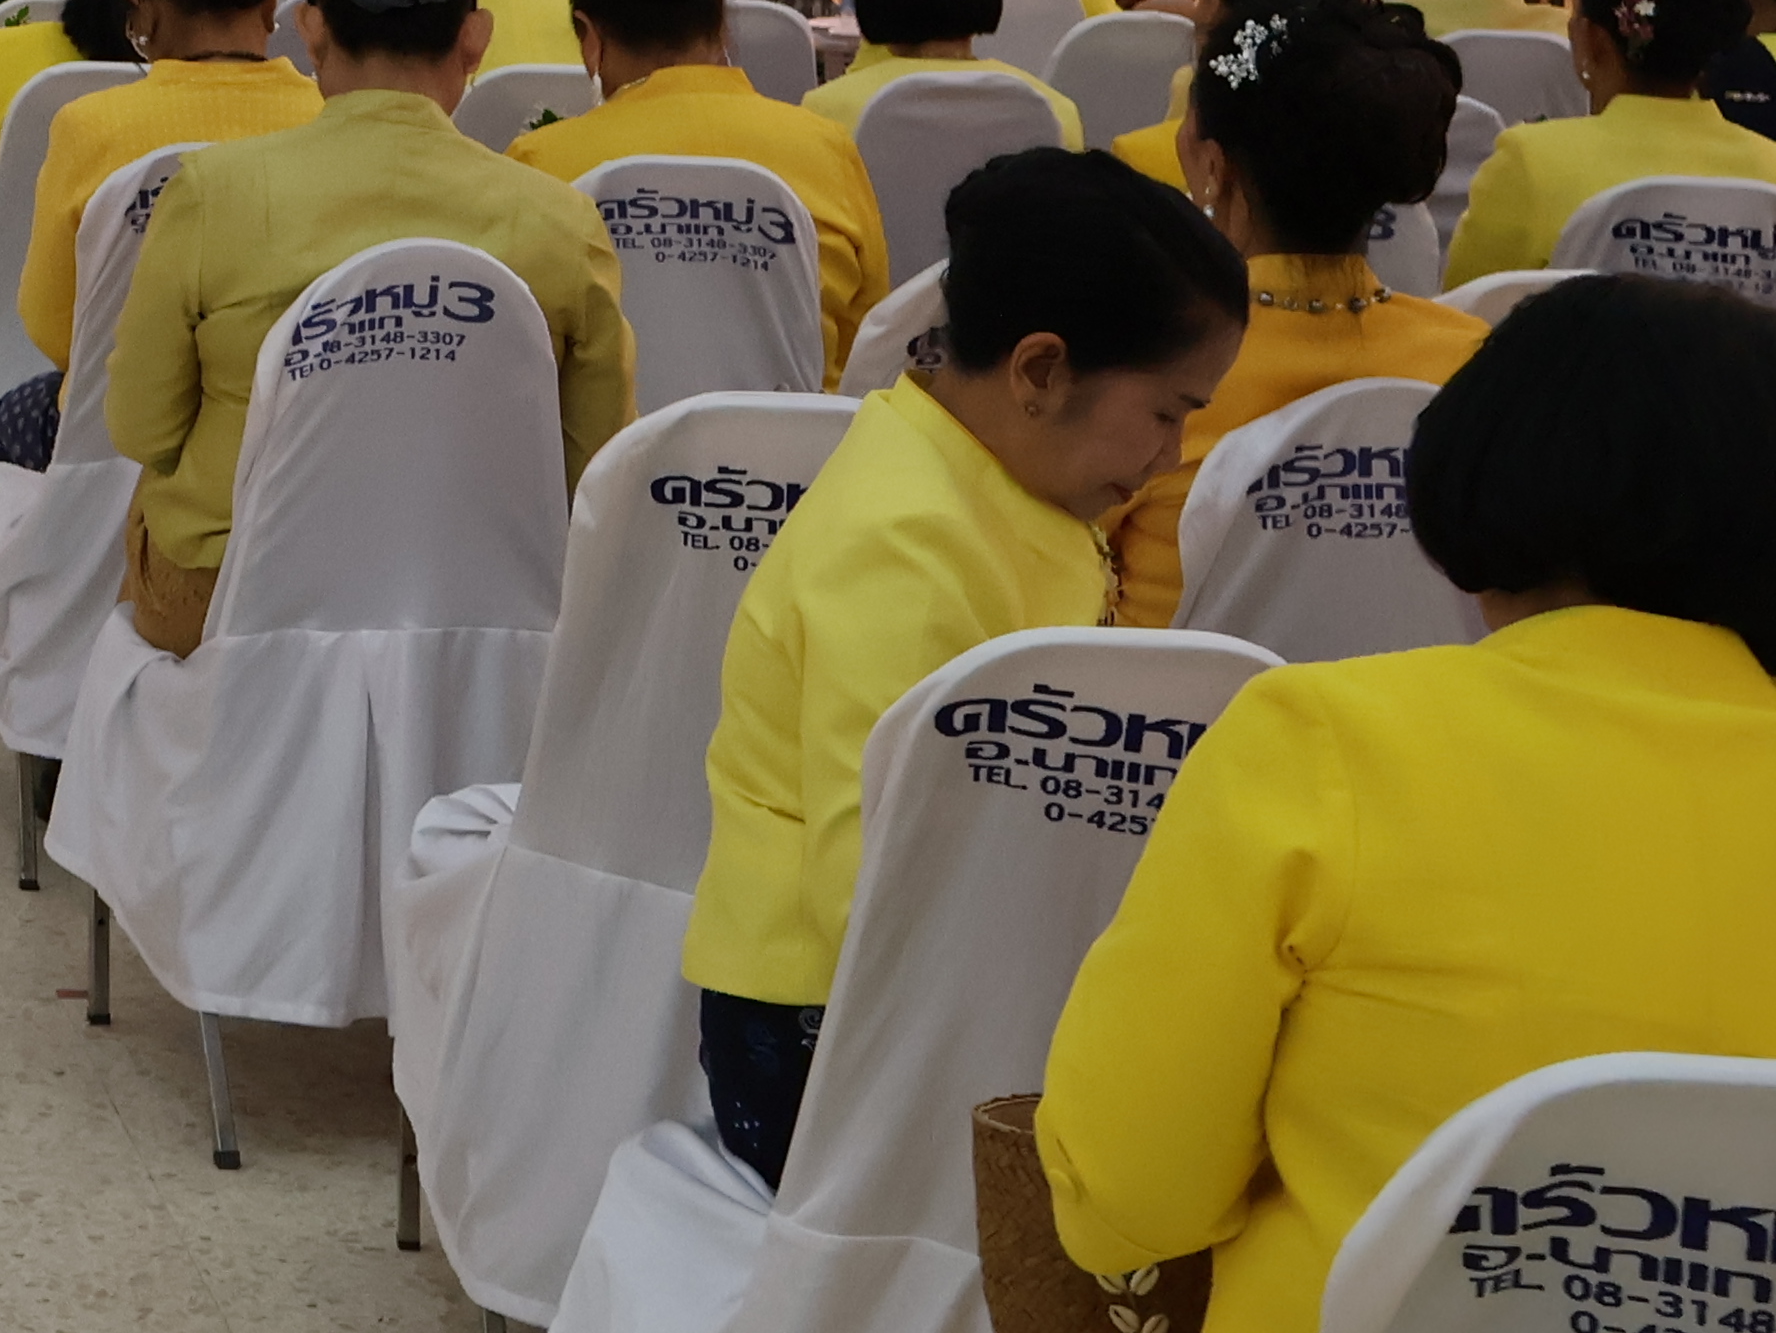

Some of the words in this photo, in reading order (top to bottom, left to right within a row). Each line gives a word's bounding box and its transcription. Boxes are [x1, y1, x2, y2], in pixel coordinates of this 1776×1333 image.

[319, 347, 457, 372] 0-4257-1214
[678, 511, 786, 535] อ.นา
[1303, 503, 1409, 520] 08-3148
[1307, 523, 1410, 539] 0-4257-
[1040, 775, 1165, 812] 08-314
[1563, 1274, 1776, 1333] 08-3148
